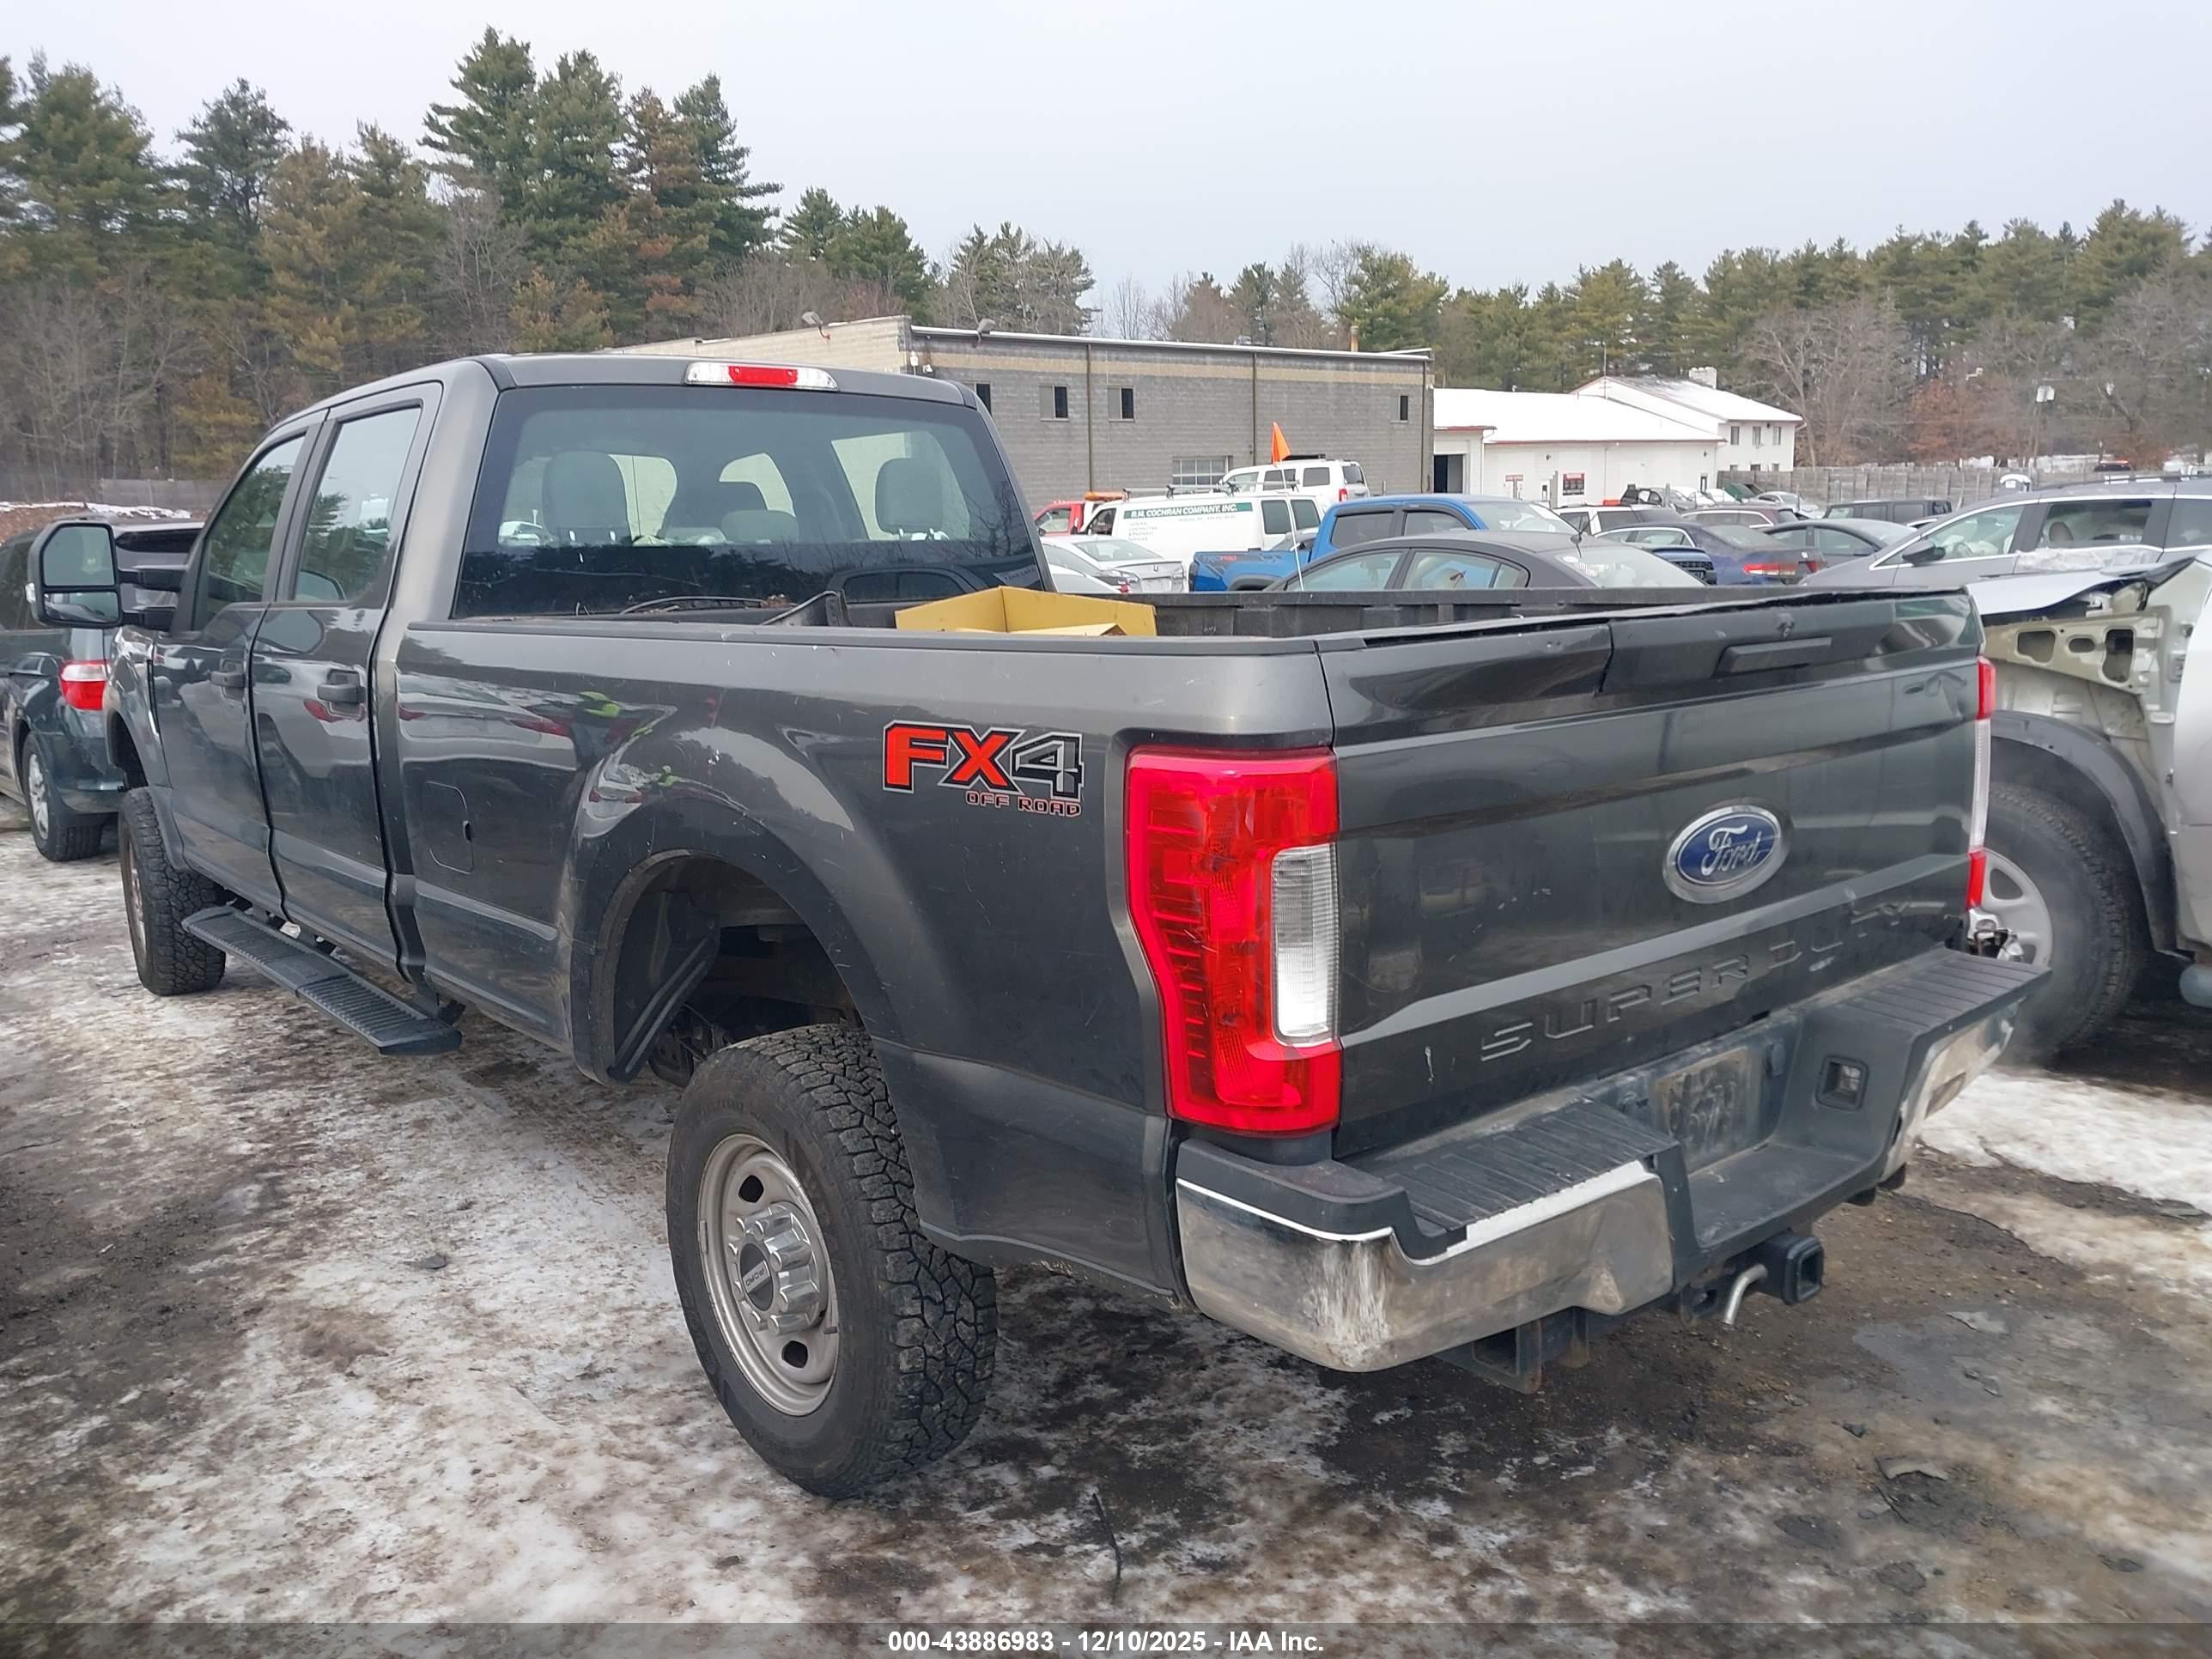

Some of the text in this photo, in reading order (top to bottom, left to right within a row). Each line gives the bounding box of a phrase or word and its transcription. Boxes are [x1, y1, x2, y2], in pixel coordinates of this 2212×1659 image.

[1146, 507, 1182, 518] COCHRAN
[883, 720, 1085, 802] FX4
[965, 790, 1082, 817] OFF ROAD
[1700, 823, 1763, 877] Ford
[1481, 953, 1750, 1062] SUPER
